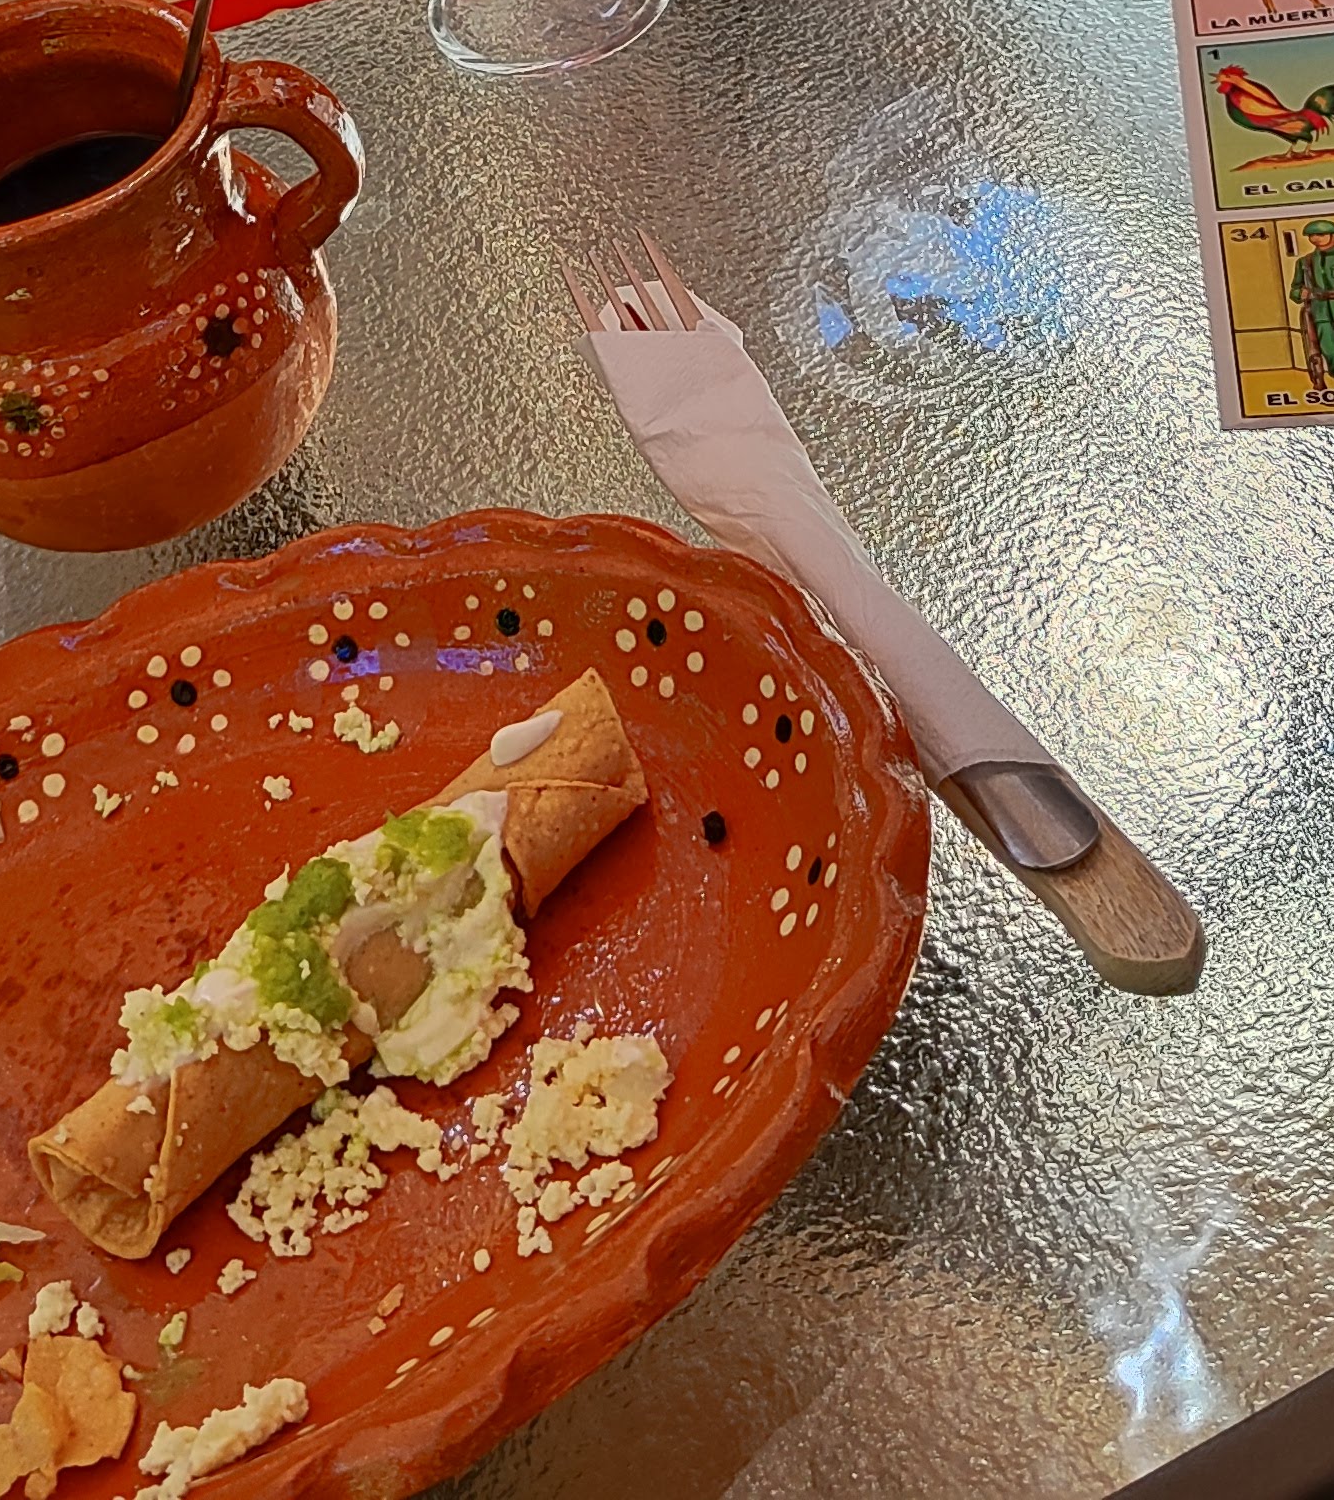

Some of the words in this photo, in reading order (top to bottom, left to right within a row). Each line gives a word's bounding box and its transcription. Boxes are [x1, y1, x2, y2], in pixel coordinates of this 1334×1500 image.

[1210, 18, 1241, 30] LA
[1207, 49, 1220, 60] 1
[1244, 184, 1277, 196] EL
[1230, 226, 1270, 242] 34
[1267, 393, 1298, 406] EL
